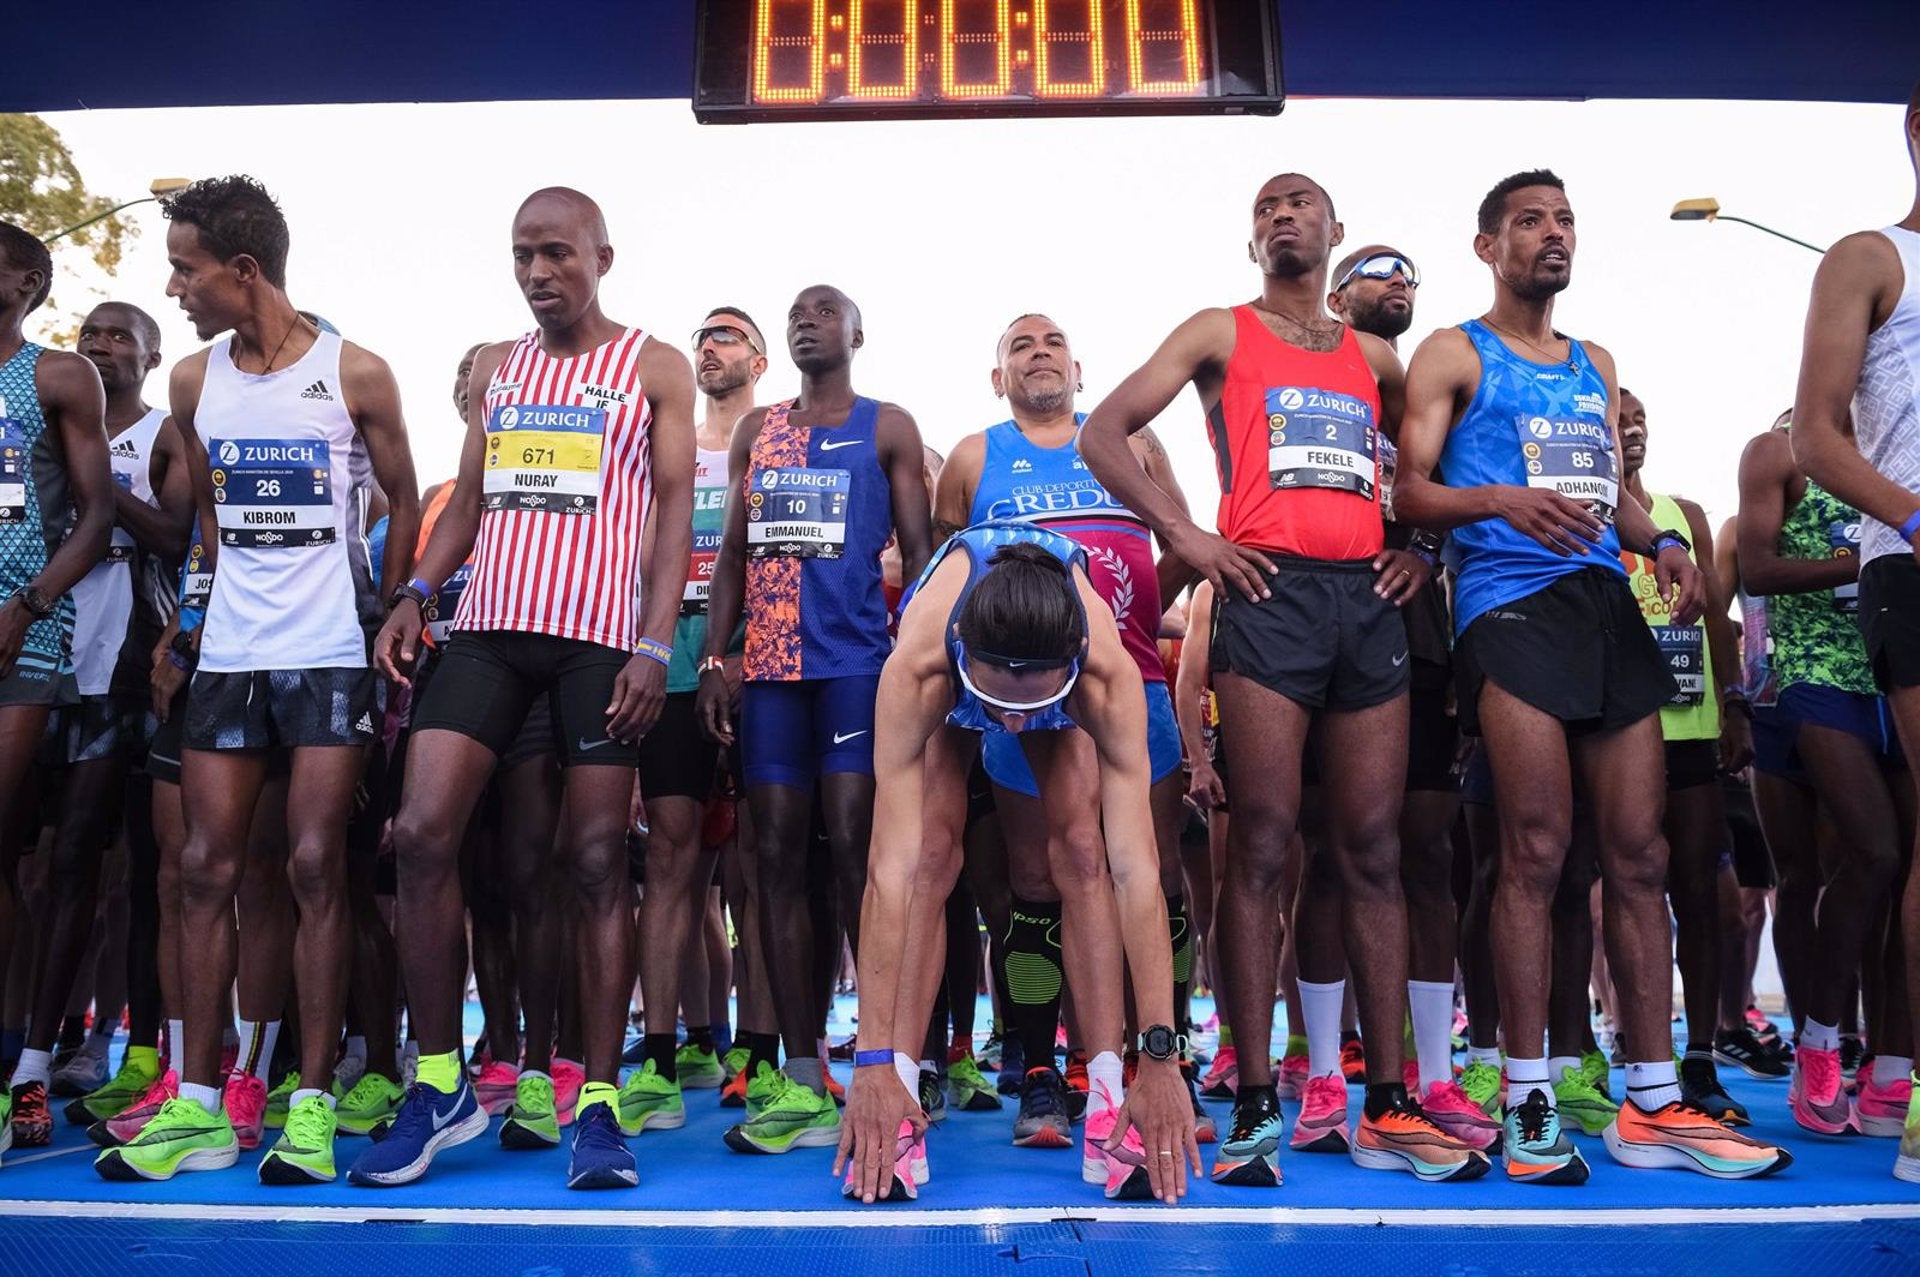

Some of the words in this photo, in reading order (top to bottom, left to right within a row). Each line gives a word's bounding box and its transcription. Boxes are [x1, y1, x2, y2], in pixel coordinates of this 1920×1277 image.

[301, 391, 334, 402] adidas
[1307, 394, 1366, 419] ZURICH
[522, 411, 590, 428] ZURICH
[1325, 424, 1338, 441] 2
[244, 447, 314, 462] ZURICH
[522, 448, 556, 465] 671
[1307, 451, 1355, 468] FEKELE
[1571, 452, 1594, 468] 85
[514, 473, 559, 488] NURAY
[780, 473, 838, 487] ZURICH
[256, 479, 281, 497] 26
[1012, 484, 1044, 497] CLUB
[694, 490, 727, 510] LE
[786, 500, 806, 515] 10
[243, 511, 296, 525] KIBROM
[765, 526, 824, 539] EMMANUEL
[305, 539, 331, 547] ZURICH
[695, 535, 722, 547] ZUR
[1670, 654, 1690, 668] 49
